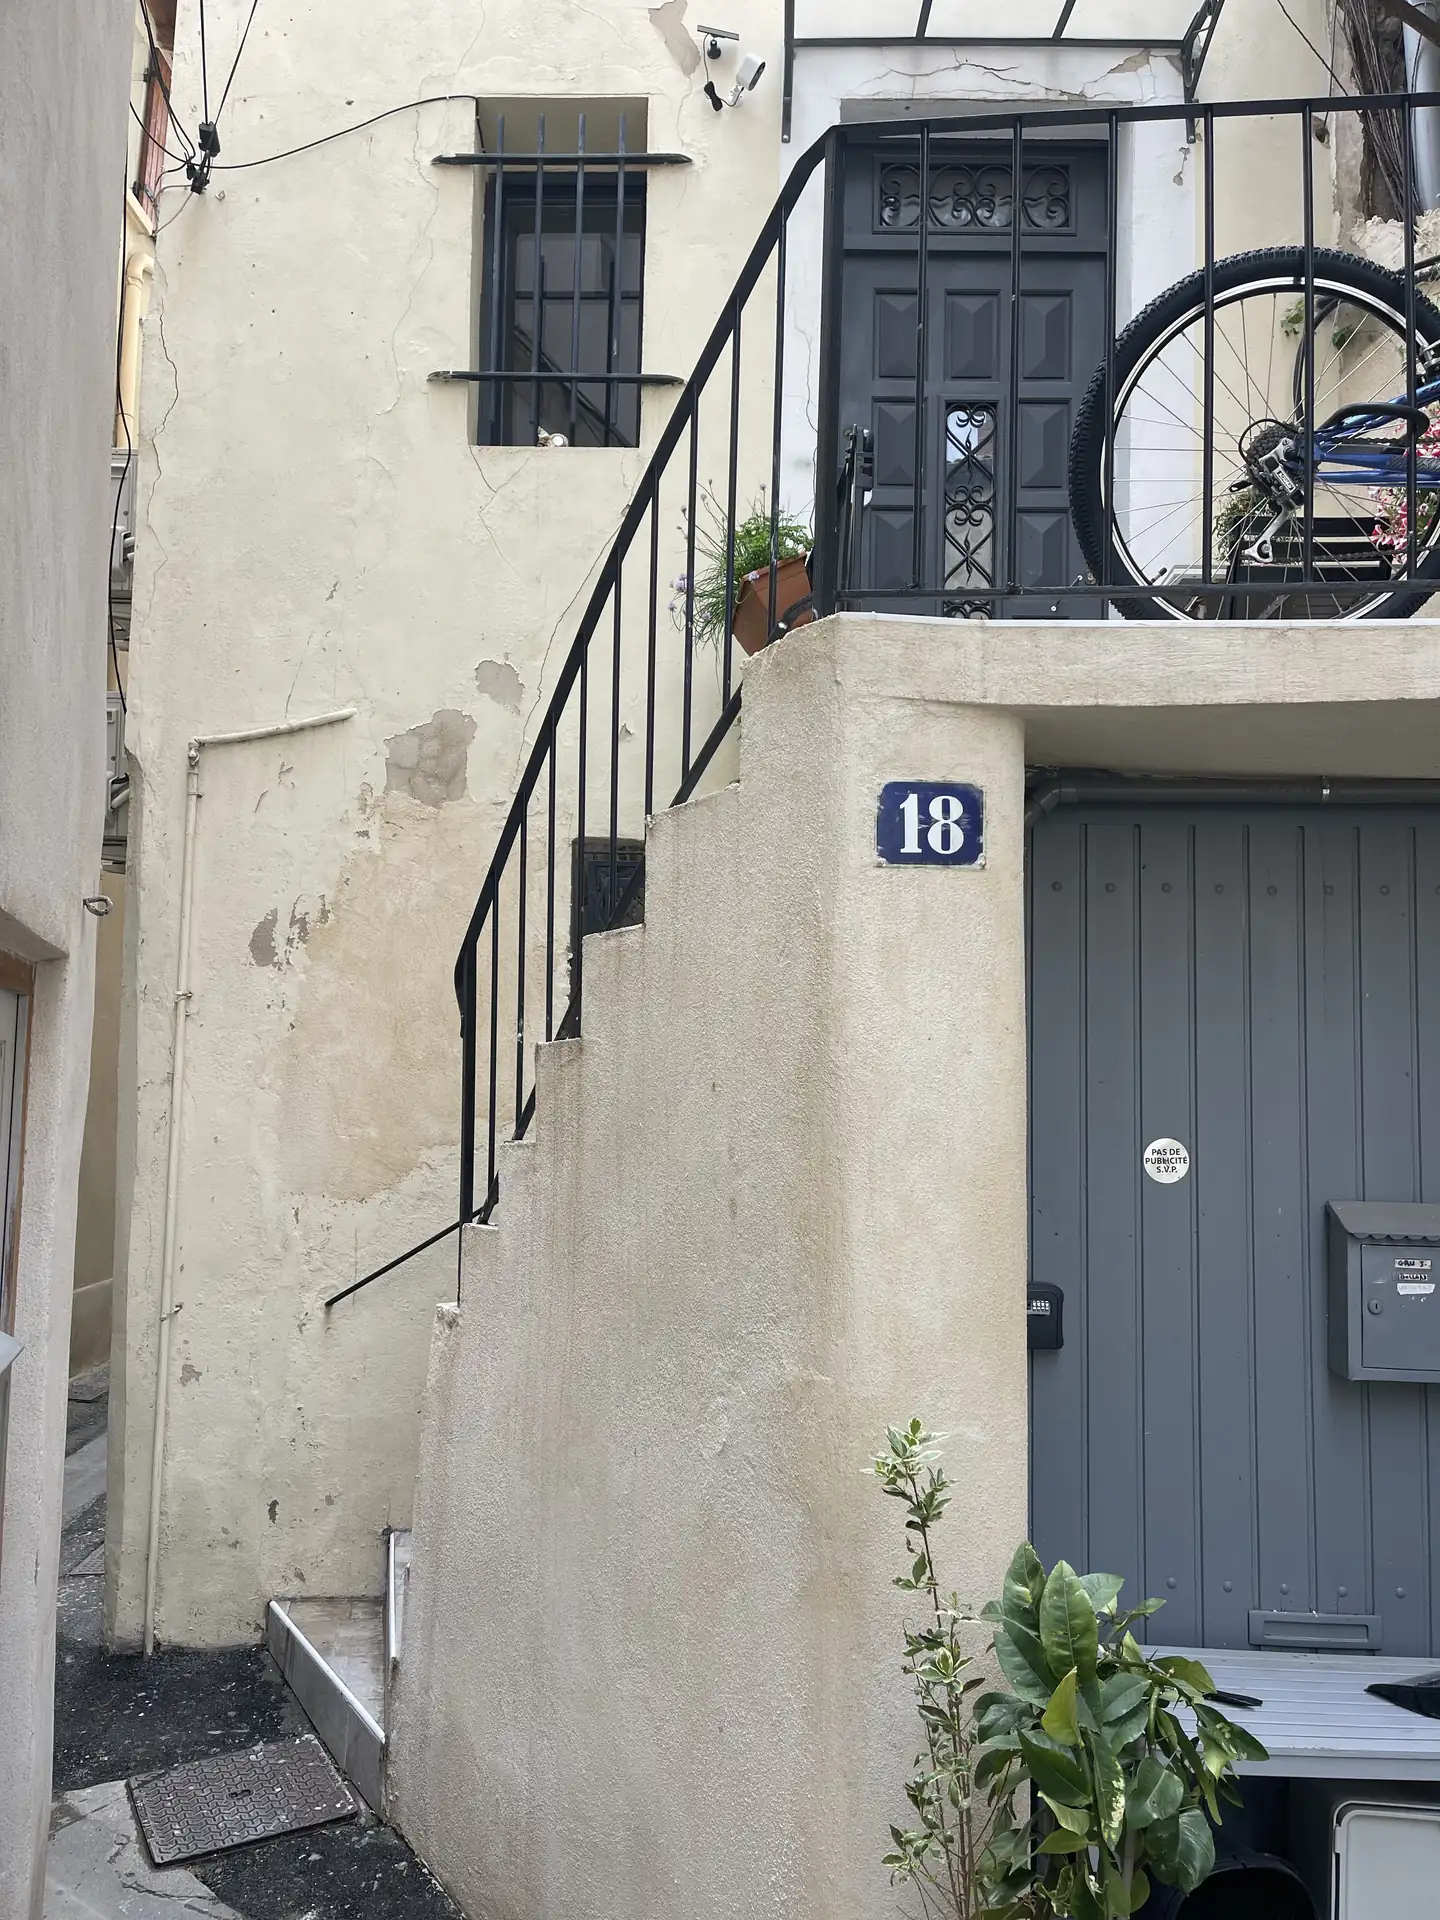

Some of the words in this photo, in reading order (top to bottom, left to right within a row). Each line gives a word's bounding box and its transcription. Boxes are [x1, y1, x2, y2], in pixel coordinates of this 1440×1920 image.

[899, 793, 965, 855] 18
[1151, 1148, 1167, 1156] PAS
[1169, 1148, 1181, 1156] DE
[1145, 1155, 1188, 1164] PUBLICITÉ
[1156, 1165, 1178, 1173] S.V.P.
